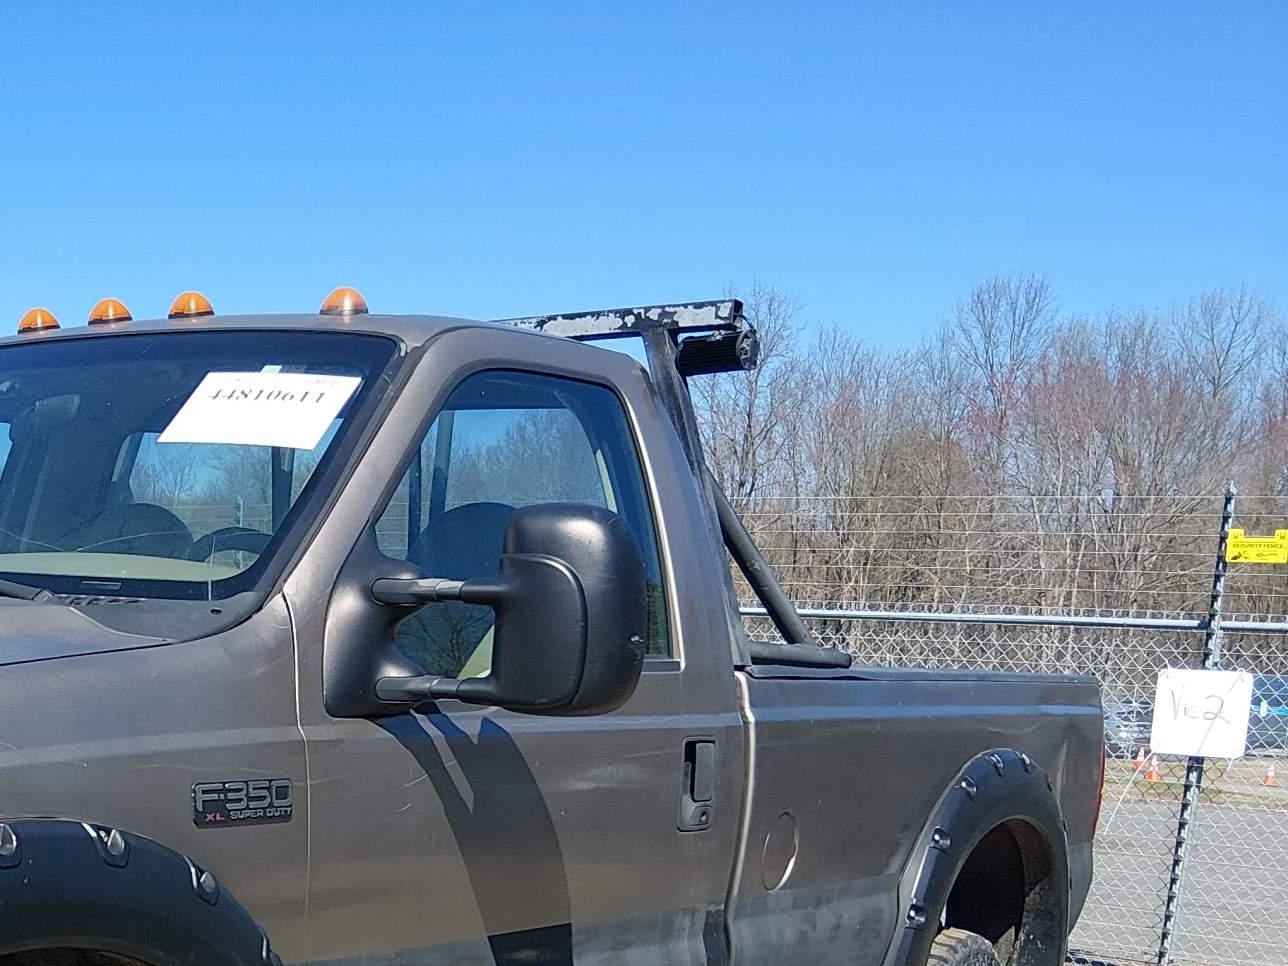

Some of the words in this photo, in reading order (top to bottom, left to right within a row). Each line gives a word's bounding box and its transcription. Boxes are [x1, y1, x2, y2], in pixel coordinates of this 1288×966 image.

[208, 388, 326, 404] 44810611
[205, 812, 225, 822] XL
[229, 809, 264, 820] SUPER
[266, 806, 292, 818] DUTY
